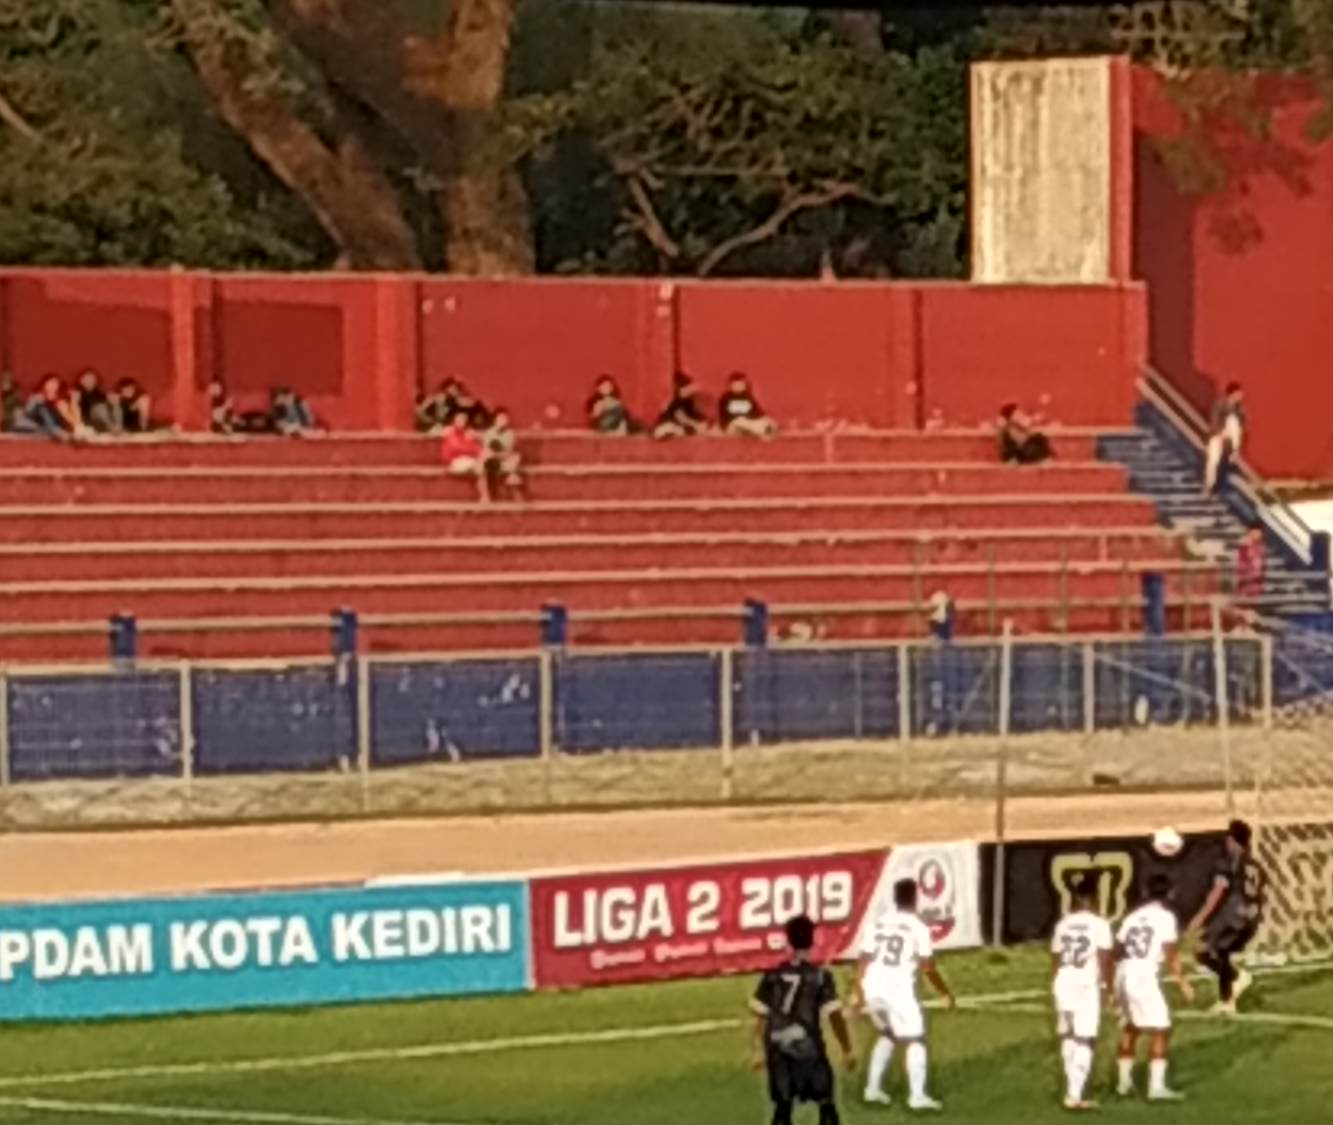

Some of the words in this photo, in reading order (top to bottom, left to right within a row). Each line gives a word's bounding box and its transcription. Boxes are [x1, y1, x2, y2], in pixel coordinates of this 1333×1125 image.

[0, 922, 153, 981] PDAM
[170, 915, 318, 973] KOTA
[331, 902, 512, 961] KEDIRI
[553, 882, 674, 949] LIGA
[686, 879, 720, 934] 2
[740, 870, 853, 930] 2019
[781, 973, 801, 1014] 7
